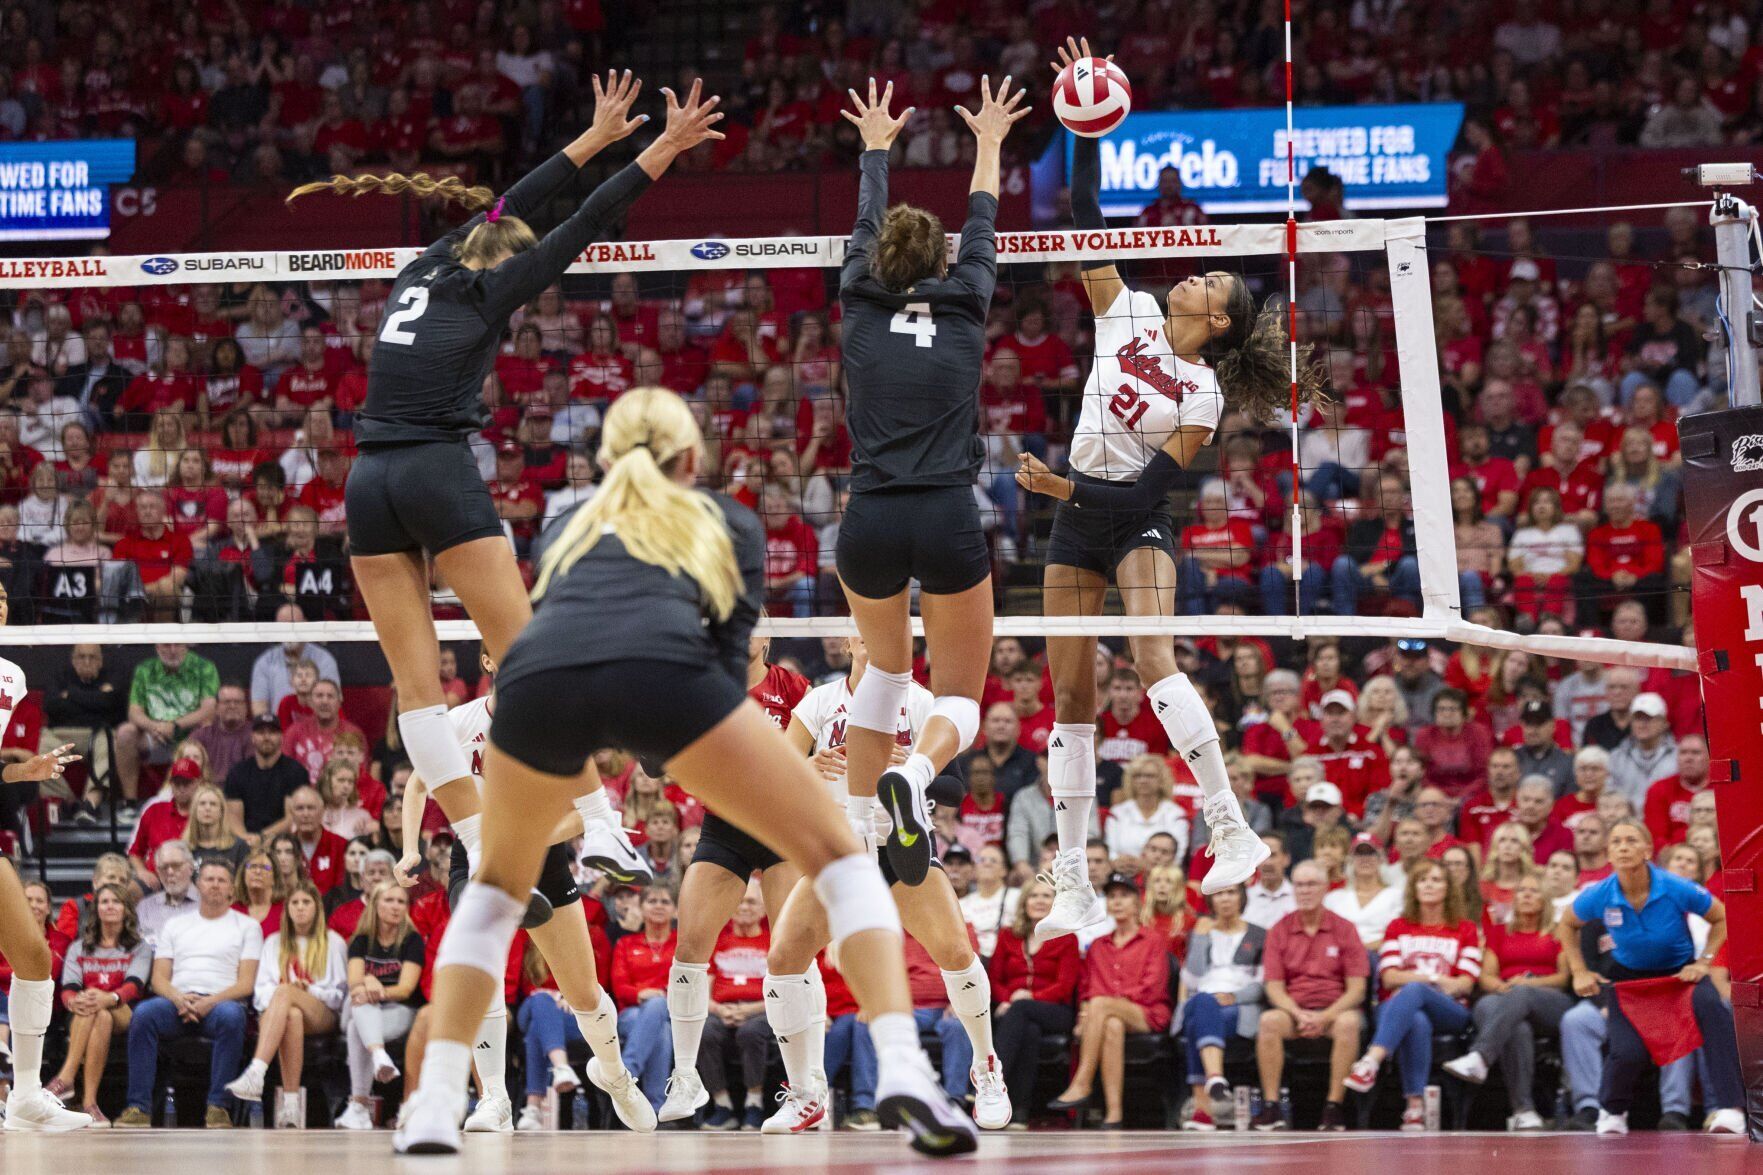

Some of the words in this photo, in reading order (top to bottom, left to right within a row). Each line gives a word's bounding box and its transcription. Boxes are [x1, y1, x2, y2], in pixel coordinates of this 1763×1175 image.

[1273, 127, 1367, 157] BREWED
[1370, 124, 1415, 154] FOR
[49, 160, 89, 187] FOR
[1099, 139, 1238, 190] Modelo
[1372, 153, 1430, 182] FANS
[0, 190, 46, 217] TIME
[51, 188, 102, 216] FANS
[736, 243, 818, 256] SUBARU
[1073, 228, 1222, 250] VOLLEYBALL
[184, 257, 264, 271] SUBARU
[289, 252, 395, 272] BEARDMORE
[379, 286, 429, 346] 2
[890, 302, 936, 348] 4
[1109, 383, 1149, 431] 21
[54, 572, 87, 598] A3
[300, 569, 333, 594] A4
